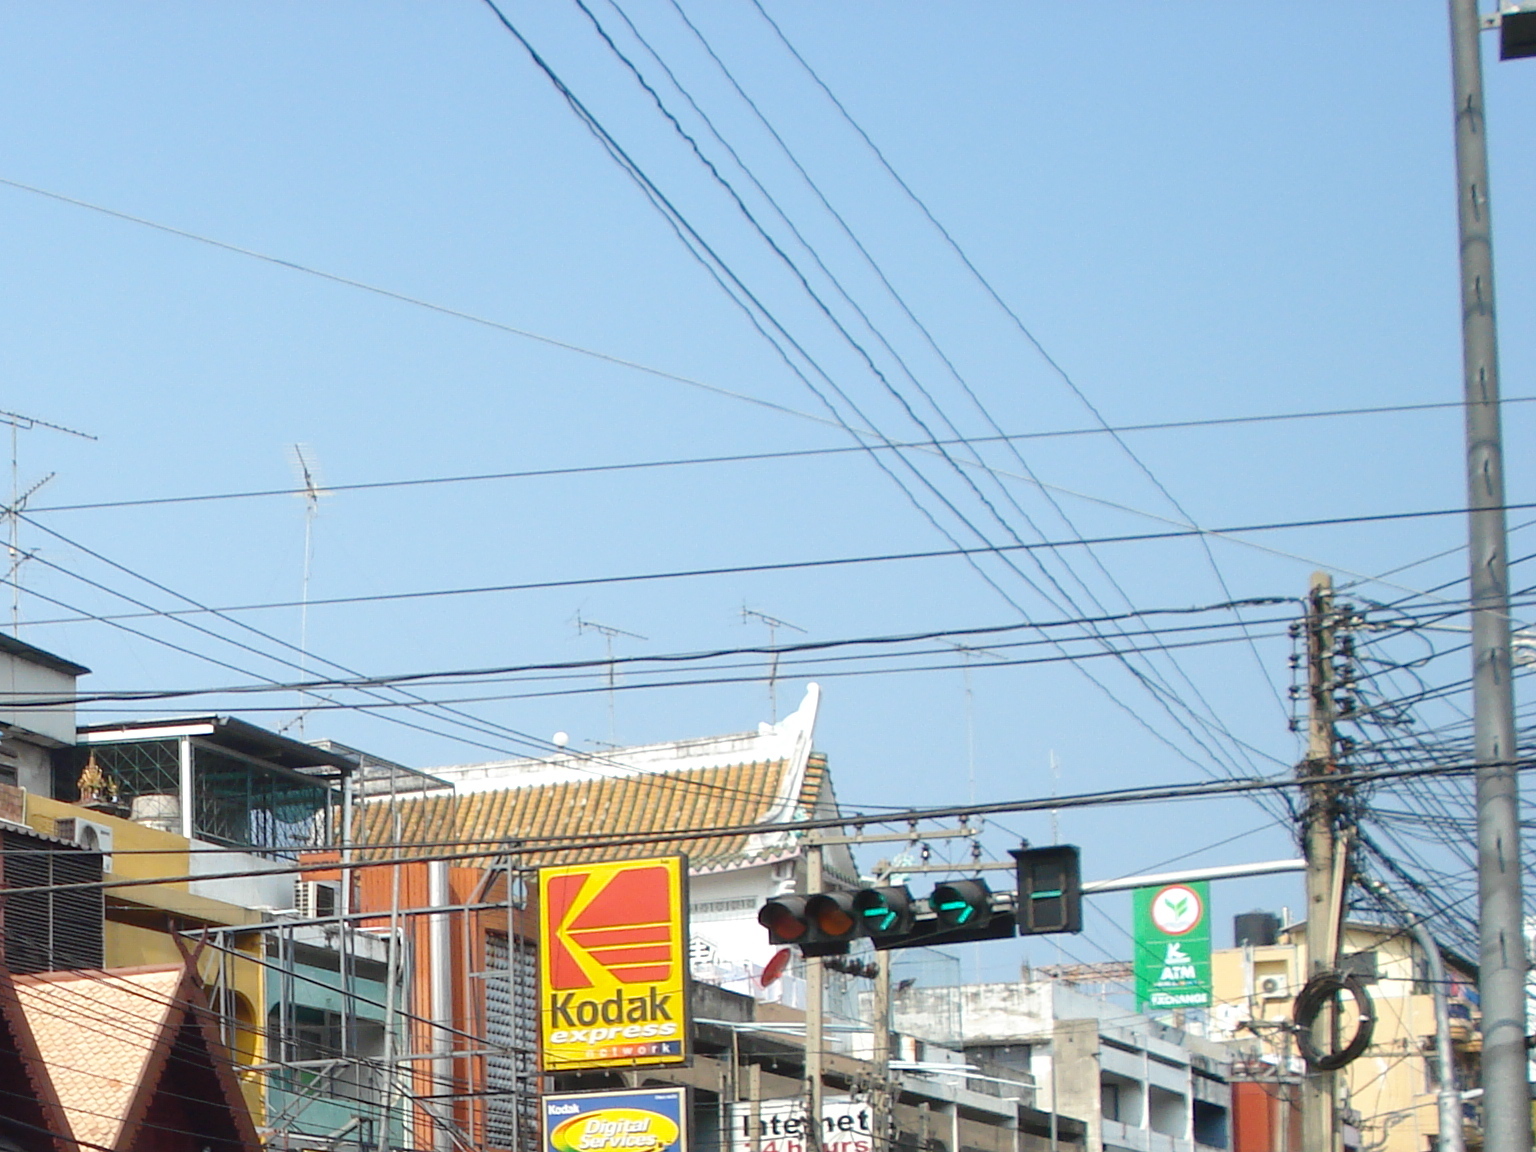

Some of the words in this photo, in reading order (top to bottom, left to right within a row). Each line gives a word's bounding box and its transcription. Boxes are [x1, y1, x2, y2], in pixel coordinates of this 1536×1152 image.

[1160, 965, 1196, 980] ATM
[551, 987, 672, 1029] Kodak
[550, 1021, 677, 1045] express
[585, 1042, 671, 1059] network
[548, 1103, 580, 1116] Kodak
[585, 1117, 651, 1138] Digital
[743, 1110, 868, 1137] Intenet
[579, 1133, 657, 1150] Services
